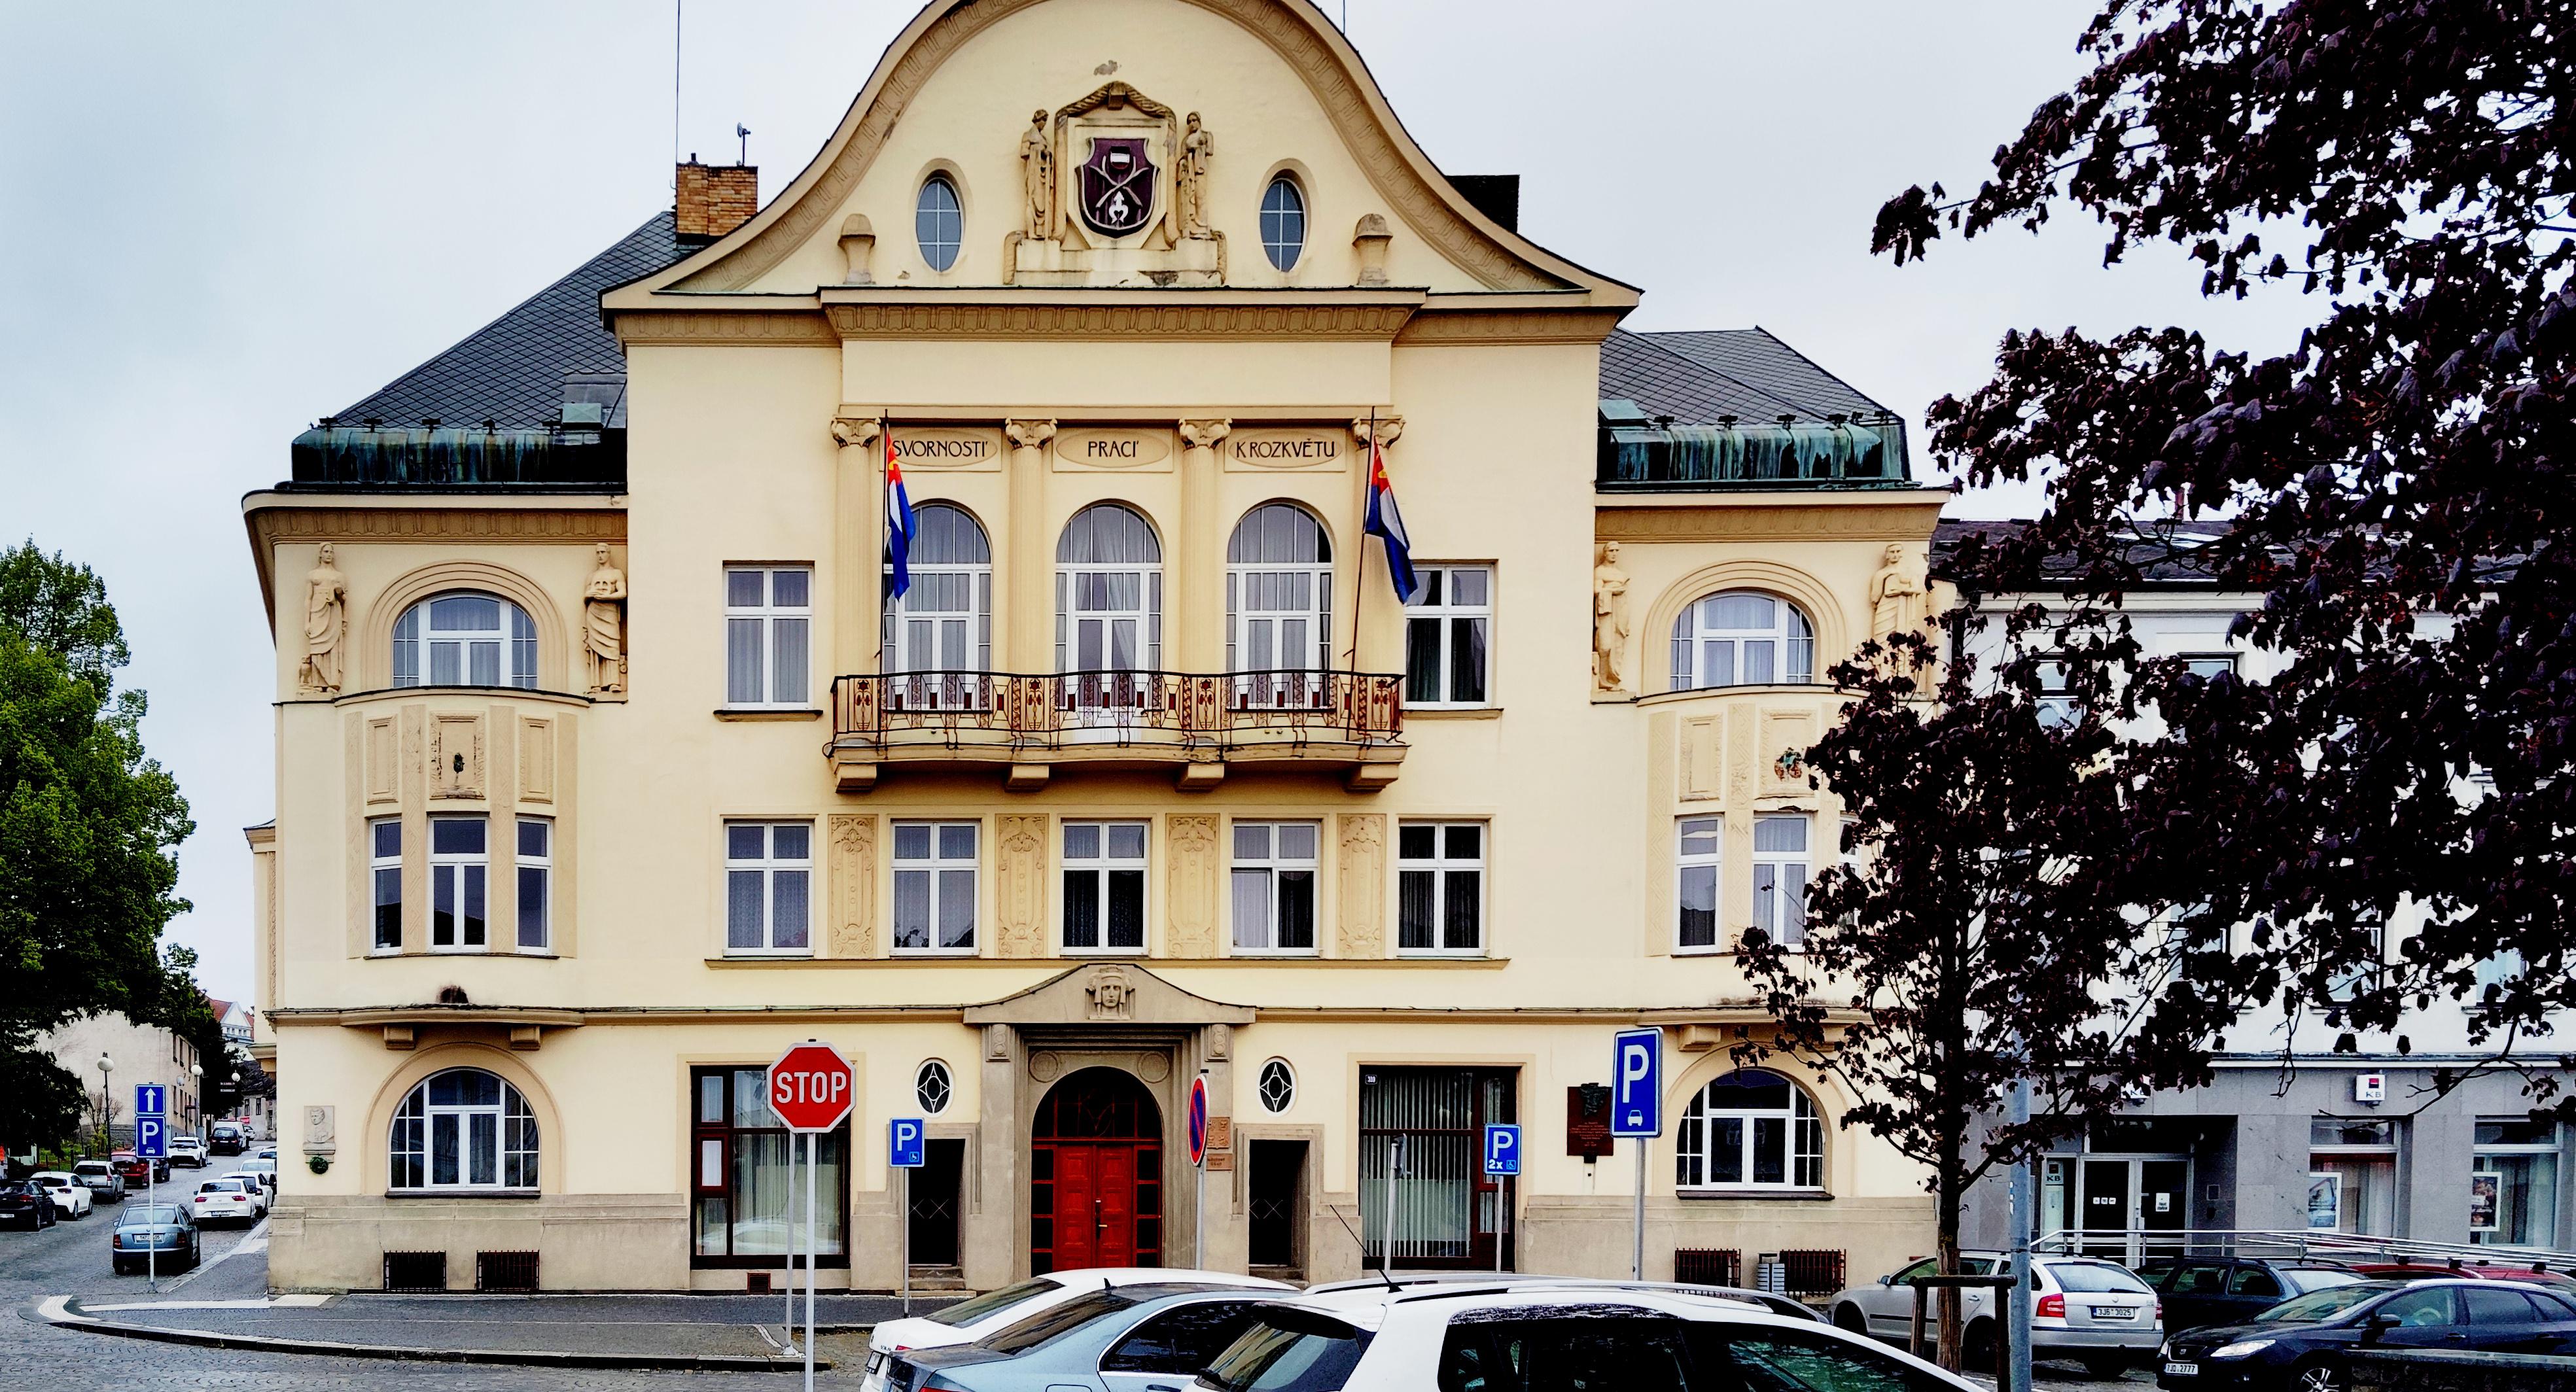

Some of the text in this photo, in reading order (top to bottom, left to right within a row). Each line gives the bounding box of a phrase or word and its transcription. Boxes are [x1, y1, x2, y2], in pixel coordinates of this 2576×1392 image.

[892, 441, 988, 457] SVORNOSTÍ
[1088, 440, 1139, 457] PRACÍ
[1237, 438, 1335, 458] K ROZKVĚTU
[1623, 1045, 1649, 1103] P
[777, 1071, 847, 1104] STOP
[142, 1121, 159, 1145] P
[897, 1123, 917, 1151] P
[1493, 1131, 1513, 1158] P
[1489, 1159, 1503, 1169] 2x
